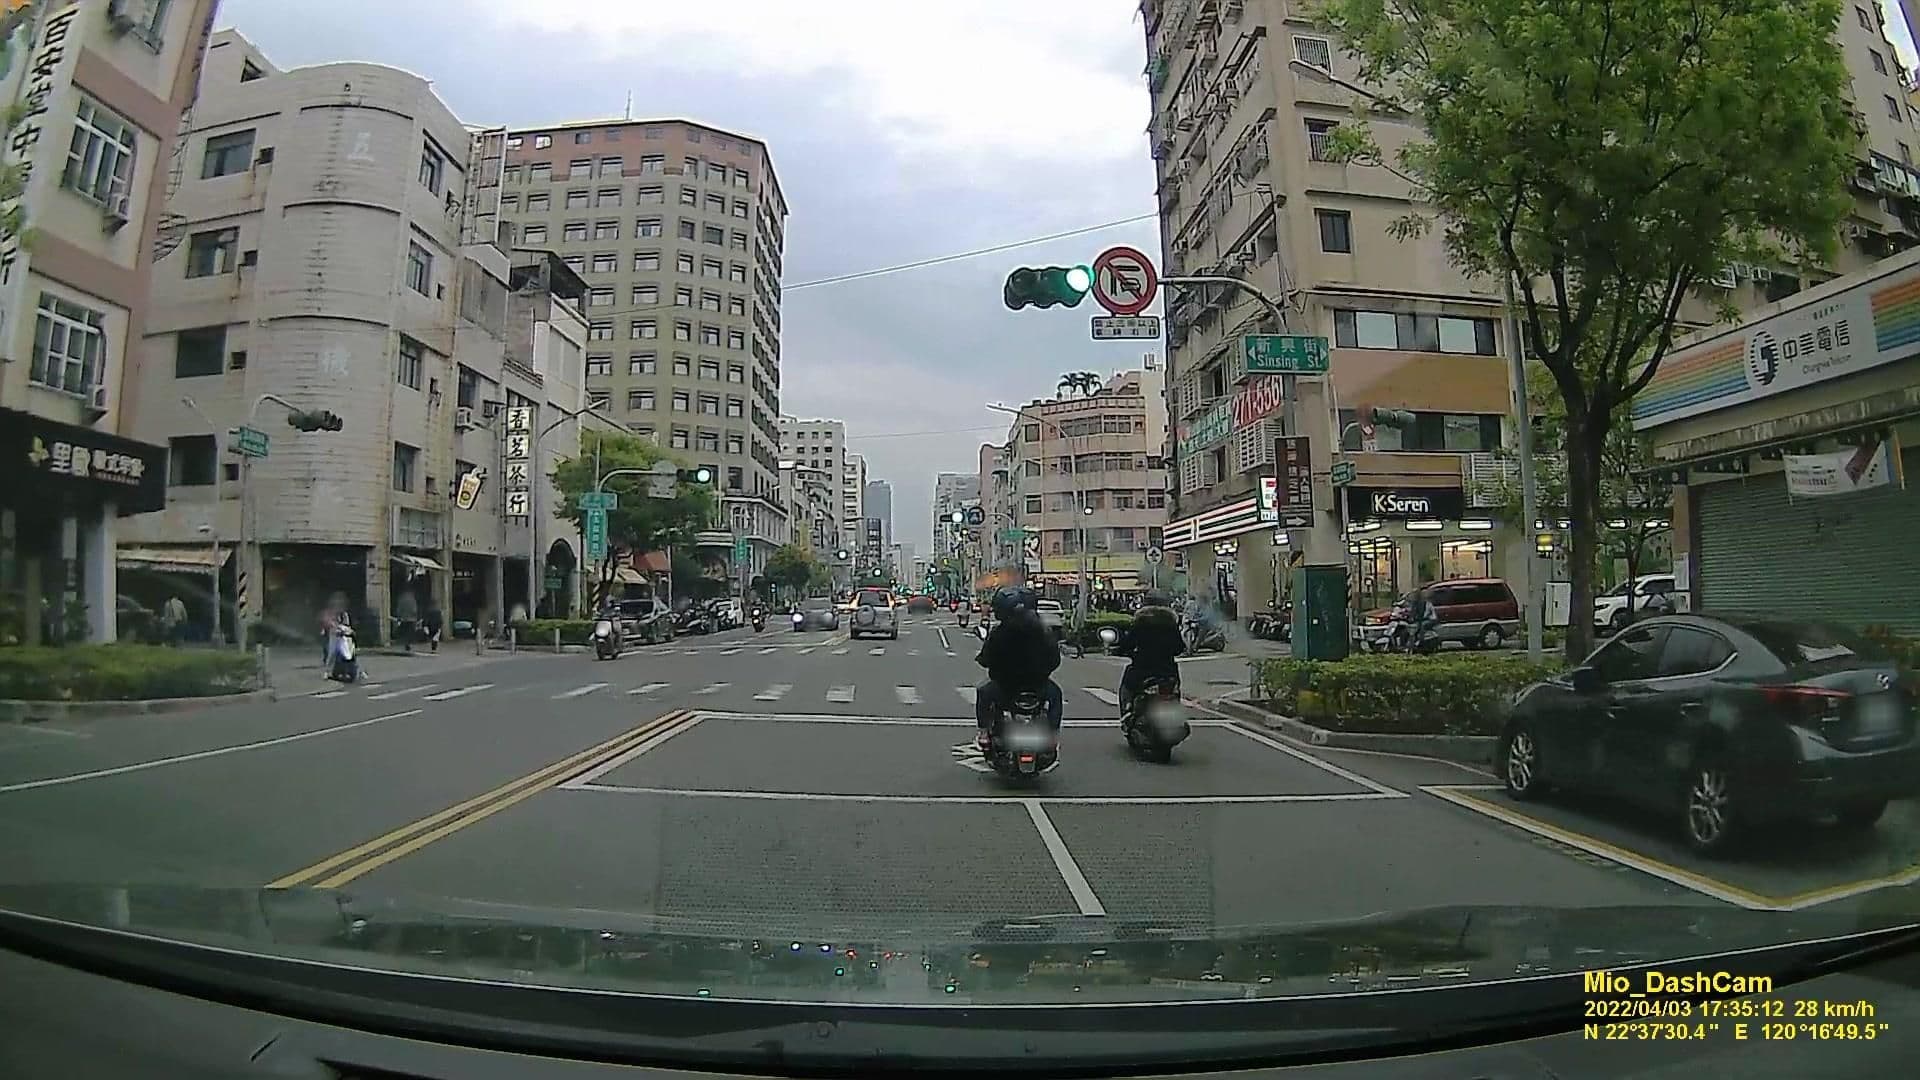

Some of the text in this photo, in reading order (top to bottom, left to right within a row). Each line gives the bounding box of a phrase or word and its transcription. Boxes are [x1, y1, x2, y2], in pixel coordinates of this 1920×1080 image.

[1256, 337, 1318, 353] 新興街
[1783, 319, 1850, 363] 中華電信
[1257, 354, 1299, 371] Sinsing
[508, 409, 527, 514] 香茗茶行
